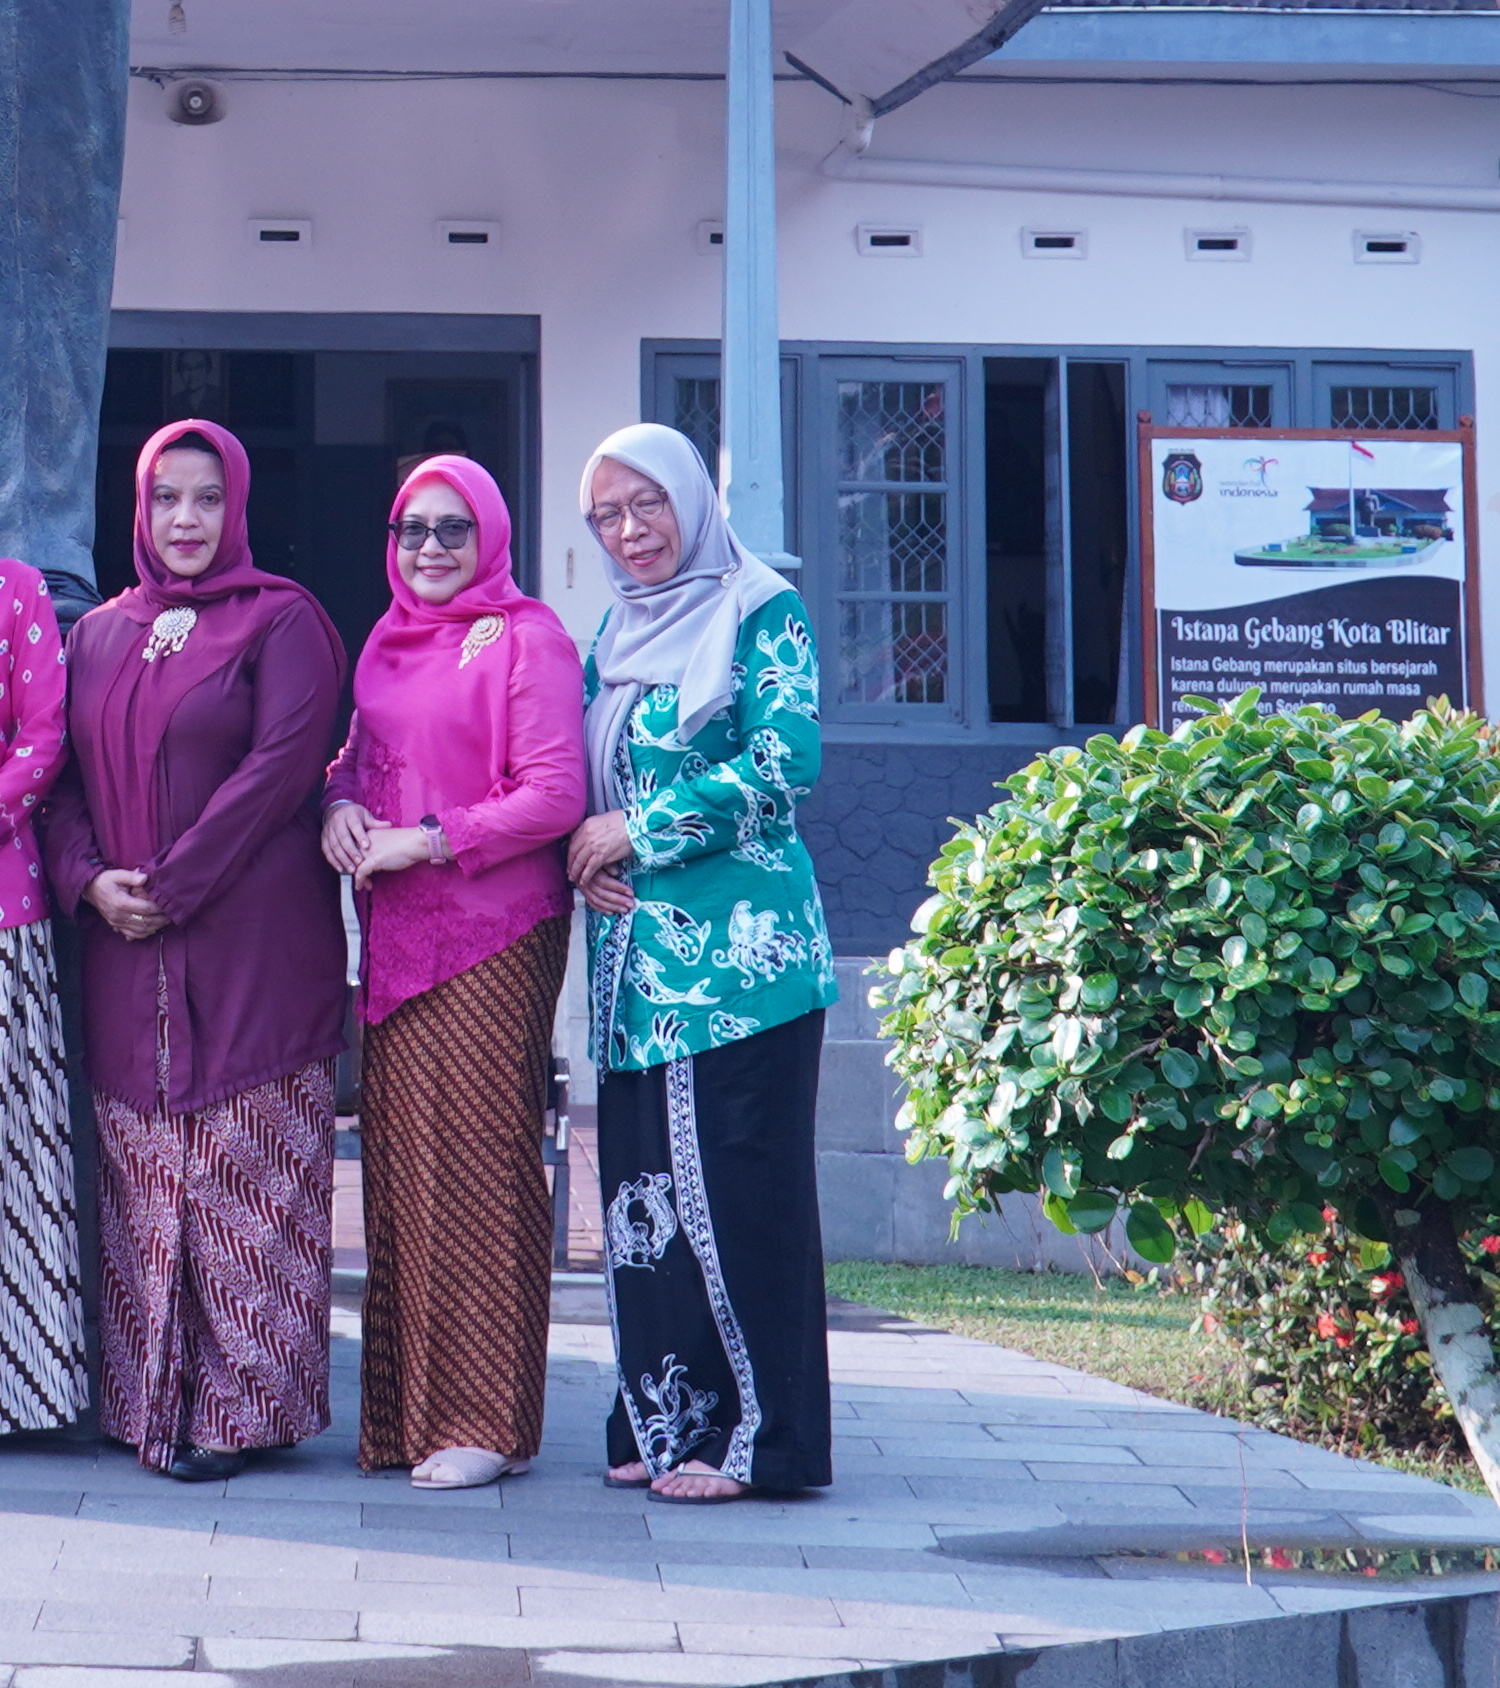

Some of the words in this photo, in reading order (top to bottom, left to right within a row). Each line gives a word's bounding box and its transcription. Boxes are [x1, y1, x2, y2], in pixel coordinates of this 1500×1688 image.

[1219, 486, 1279, 498] indonesia
[1171, 616, 1239, 643] Istana
[1244, 617, 1324, 650] Gebang
[1327, 617, 1382, 648] Kota
[1385, 619, 1451, 645] Blitar
[1171, 656, 1209, 672] Istana
[1212, 656, 1261, 676] Gebang
[1264, 658, 1334, 676] merupakan
[1337, 658, 1368, 674] situs
[1370, 659, 1438, 679] bersejarah
[1171, 676, 1214, 692] karena
[1270, 679, 1341, 697] merupakan
[1343, 679, 1384, 695] rumah
[1386, 682, 1421, 696] masa
